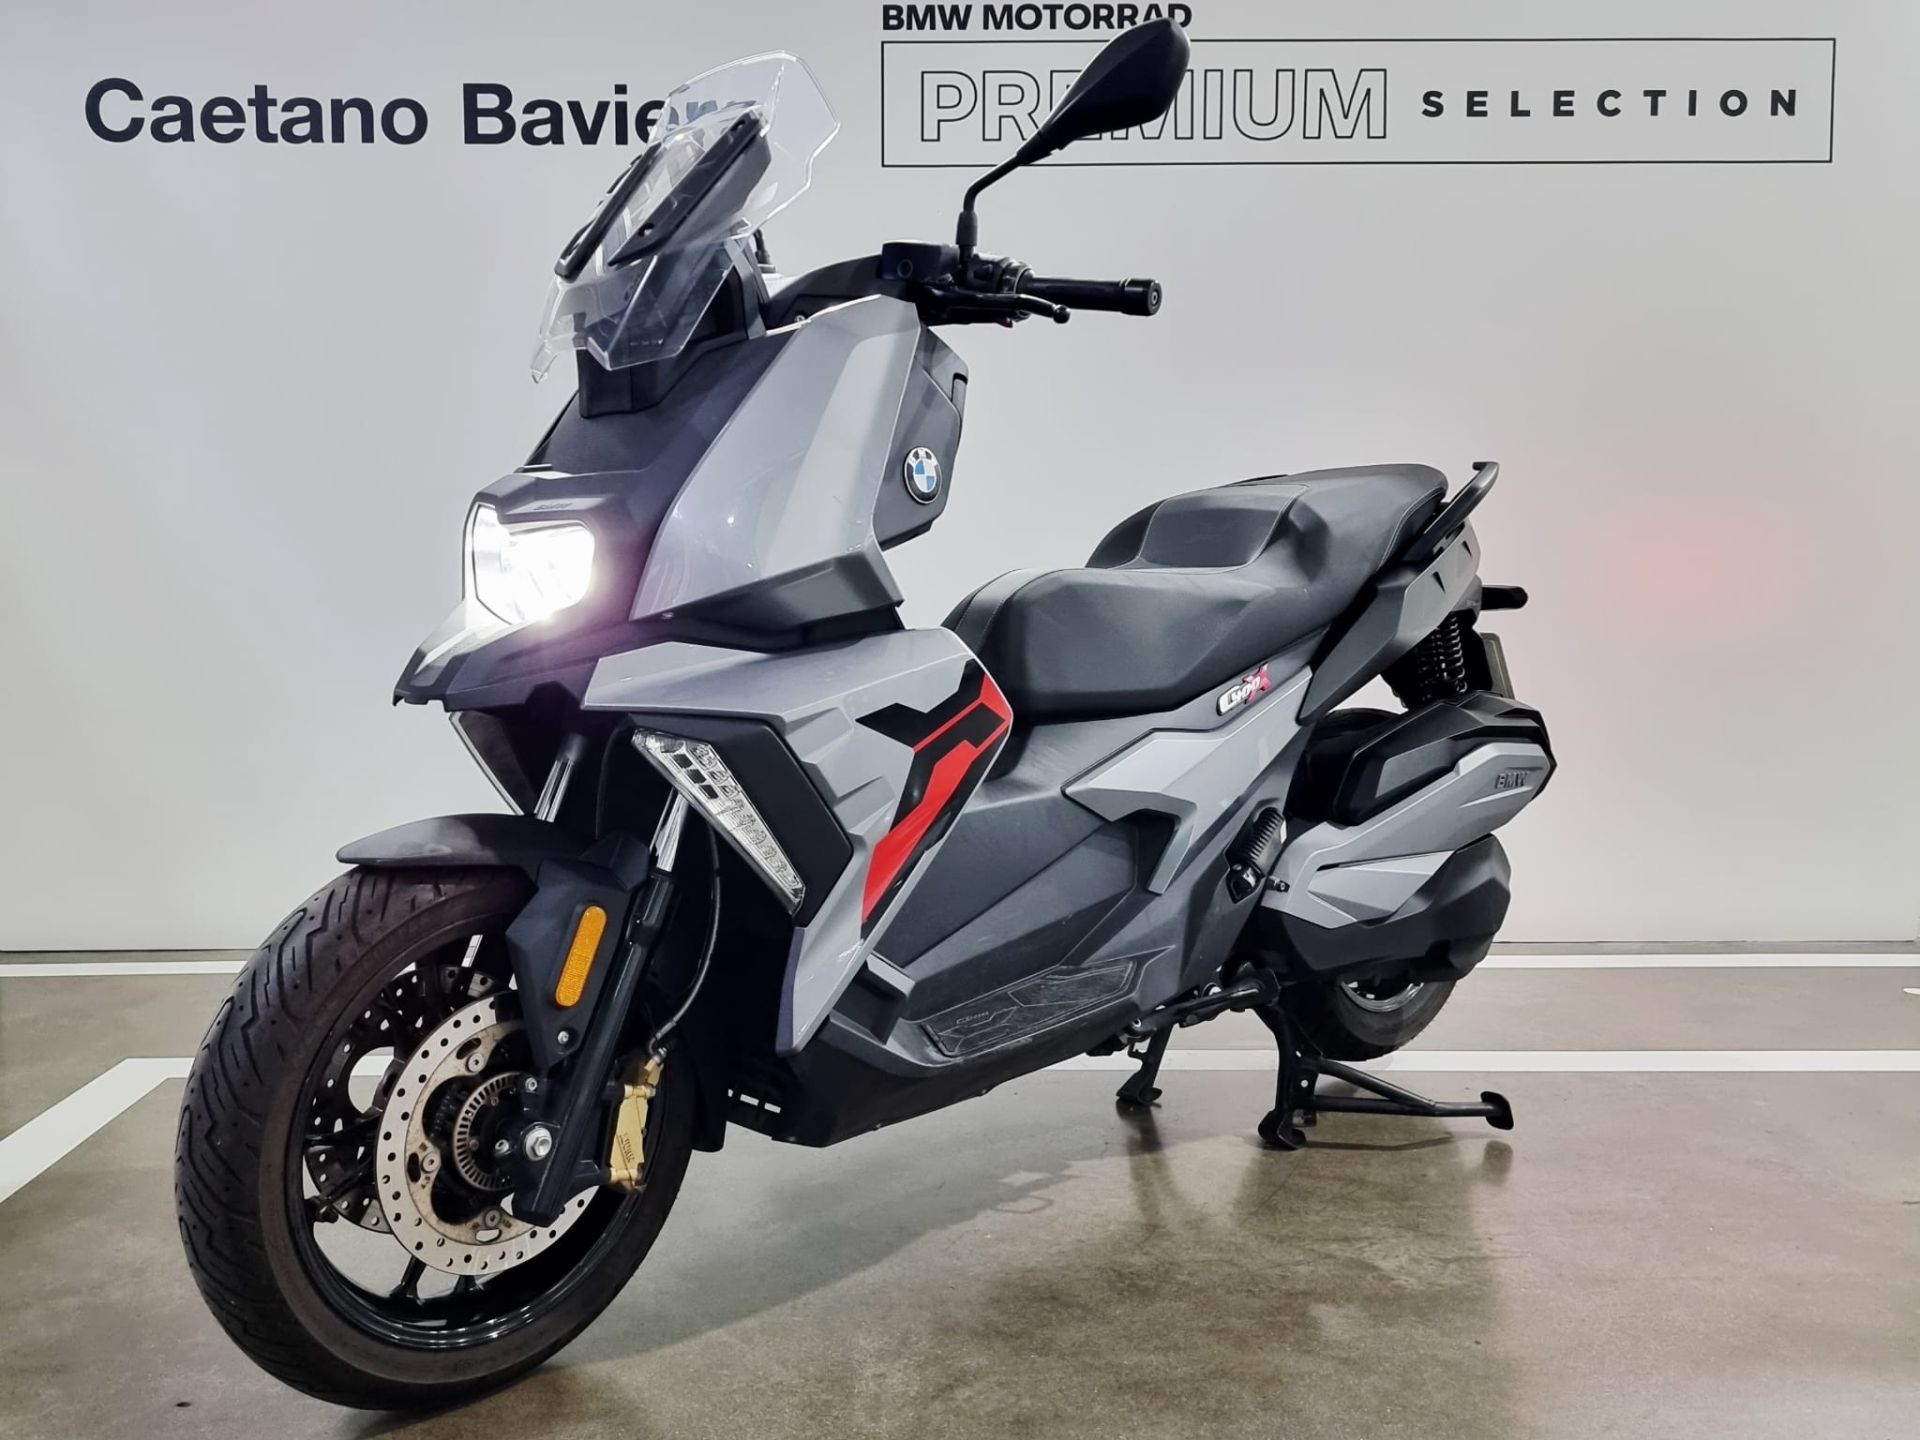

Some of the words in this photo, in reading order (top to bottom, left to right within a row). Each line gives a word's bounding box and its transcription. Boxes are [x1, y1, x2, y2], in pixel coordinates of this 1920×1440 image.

[882, 4, 972, 30] BMW
[983, 3, 1192, 30] MOTORRAD
[85, 78, 428, 144] Caetano
[920, 68, 1387, 142] PRIUM
[1421, 89, 1797, 118] SELECTION
